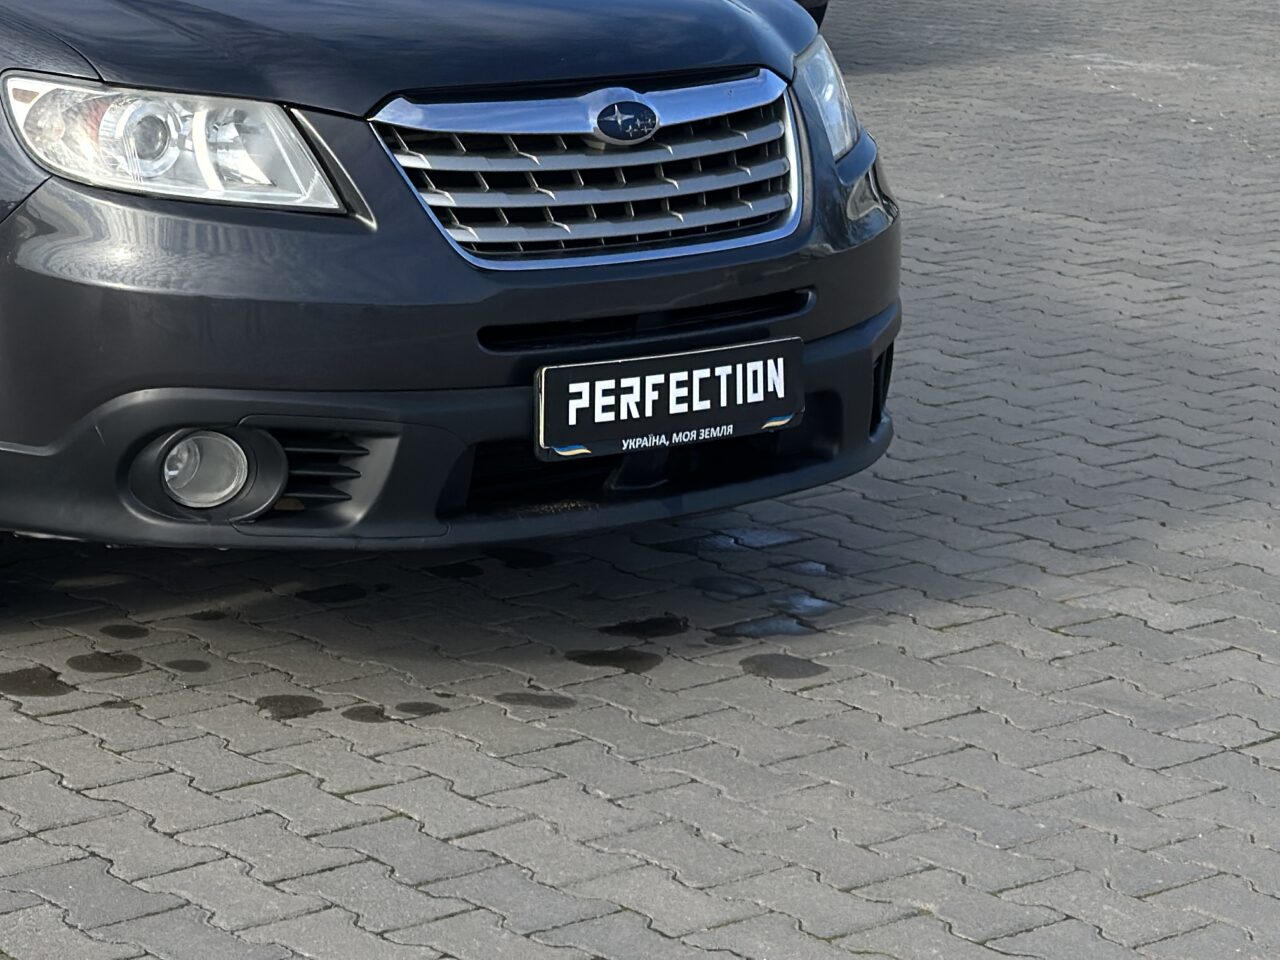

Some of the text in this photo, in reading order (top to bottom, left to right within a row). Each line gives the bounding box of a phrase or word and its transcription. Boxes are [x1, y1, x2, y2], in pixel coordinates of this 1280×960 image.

[568, 356, 785, 426] PERFECTION
[621, 424, 734, 451] УКРАЇНА, МОЯ ЗЕМЛЯ
